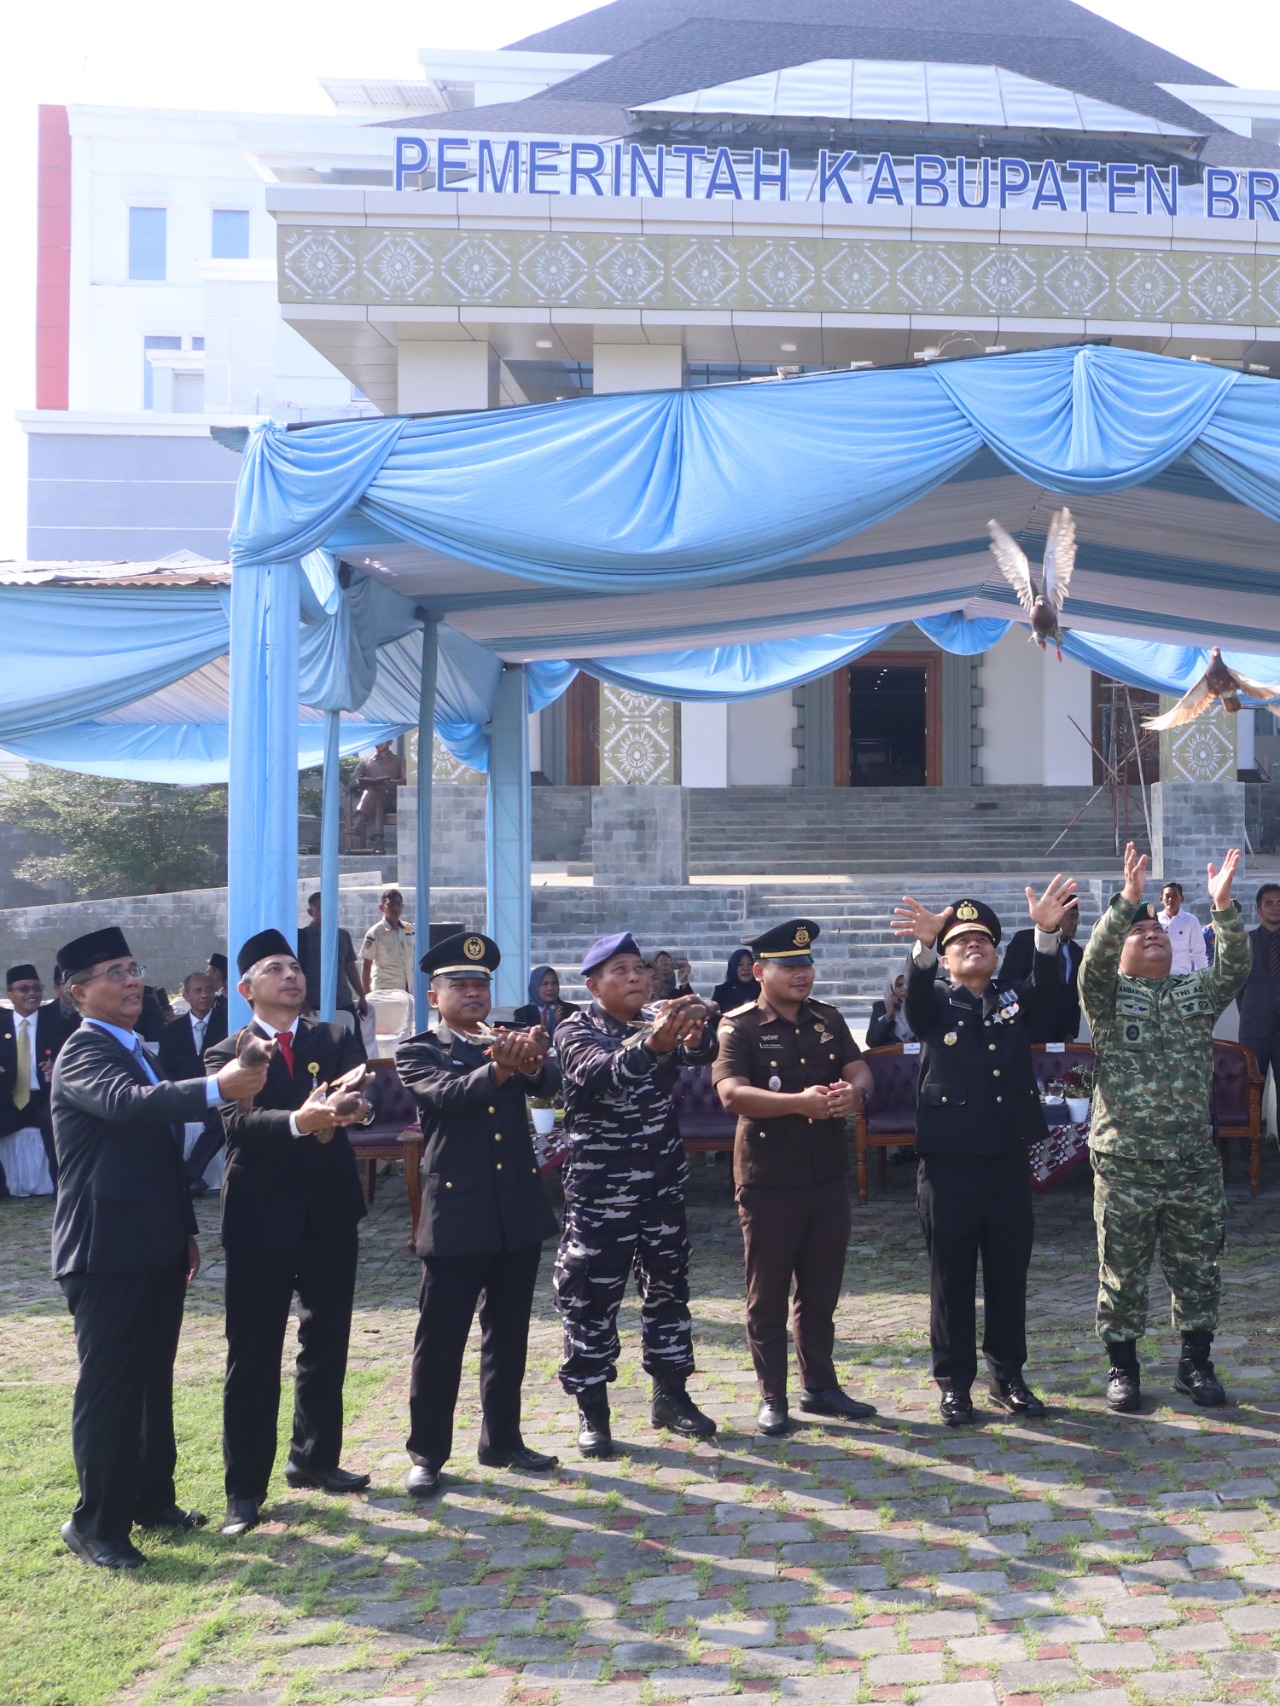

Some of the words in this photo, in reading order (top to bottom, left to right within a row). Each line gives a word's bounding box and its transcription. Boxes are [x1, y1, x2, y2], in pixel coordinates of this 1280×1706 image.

[394, 136, 788, 201] PEMERINTAH
[819, 149, 1178, 216] KABUPATEN
[1174, 990, 1191, 998] TNI
[1193, 985, 1204, 993] AD
